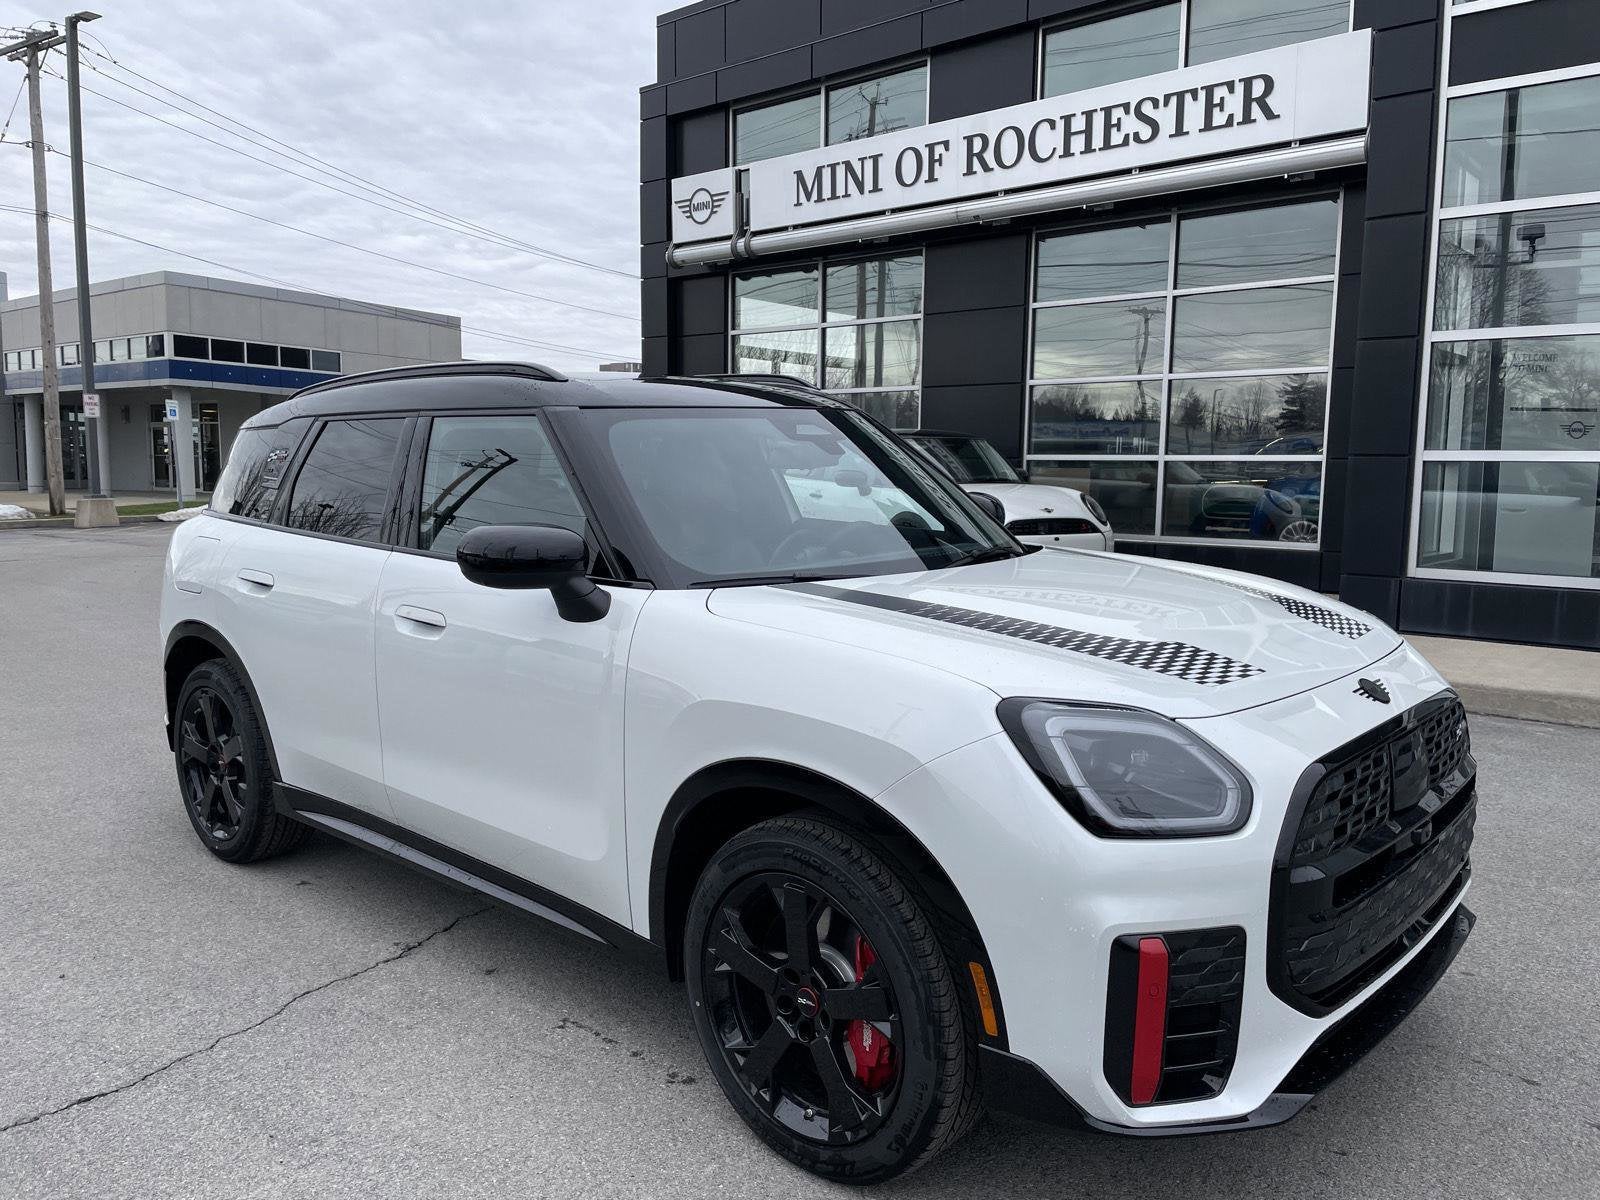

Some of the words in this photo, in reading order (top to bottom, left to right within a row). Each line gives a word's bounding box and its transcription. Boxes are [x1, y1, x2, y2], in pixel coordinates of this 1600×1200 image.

[793, 152, 883, 206] MINI
[895, 140, 950, 188] OF
[962, 73, 1280, 176] ROCHESTER
[692, 200, 711, 212] MINI
